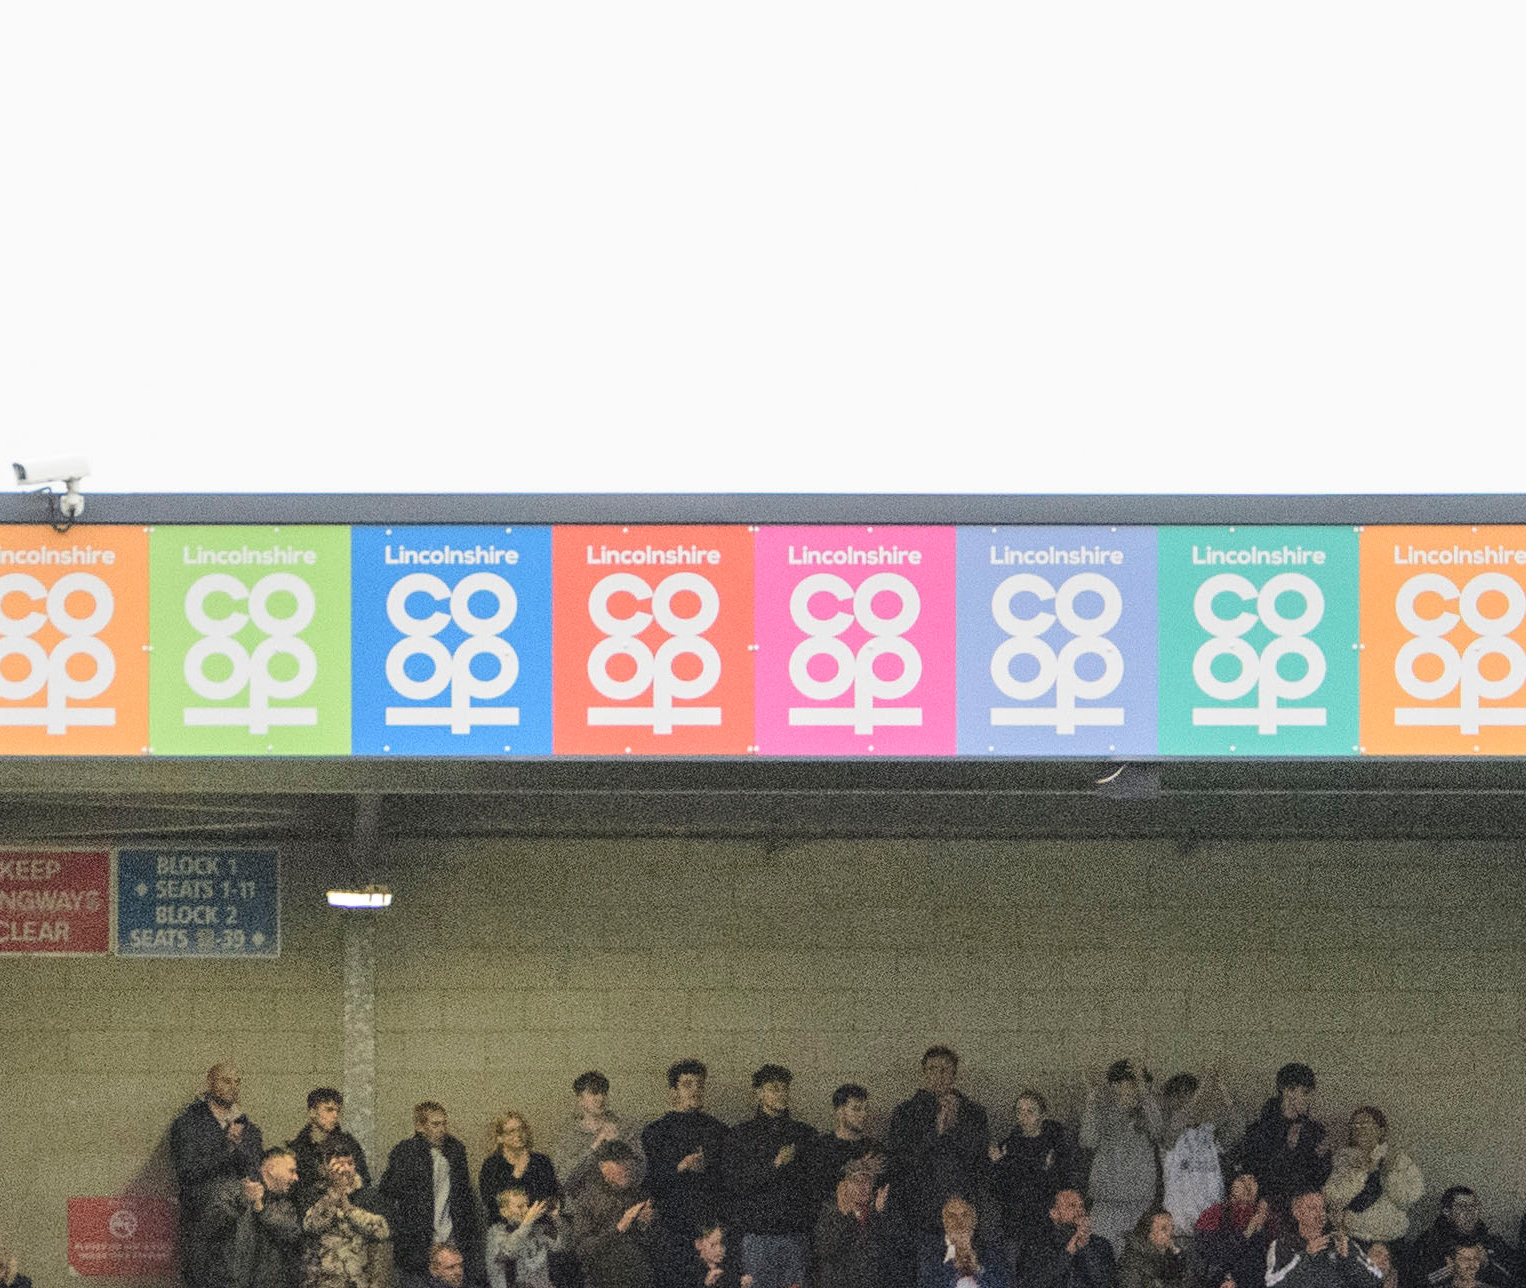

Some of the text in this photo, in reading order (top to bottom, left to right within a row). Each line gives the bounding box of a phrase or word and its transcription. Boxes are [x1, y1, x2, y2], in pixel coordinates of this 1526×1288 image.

[182, 546, 318, 566] Lincolnshire
[385, 546, 520, 566] Lincolnshire
[587, 546, 722, 566] Lincolnshire
[788, 546, 923, 566] Lincolnshire
[989, 546, 1125, 566] Lincolnshire
[1191, 546, 1327, 566] Lincolnshire
[156, 855, 239, 876] BLOCK 1
[155, 879, 256, 900] SEATS 1-11
[154, 904, 239, 925] BLOCK 2
[130, 927, 189, 949] SEATS
